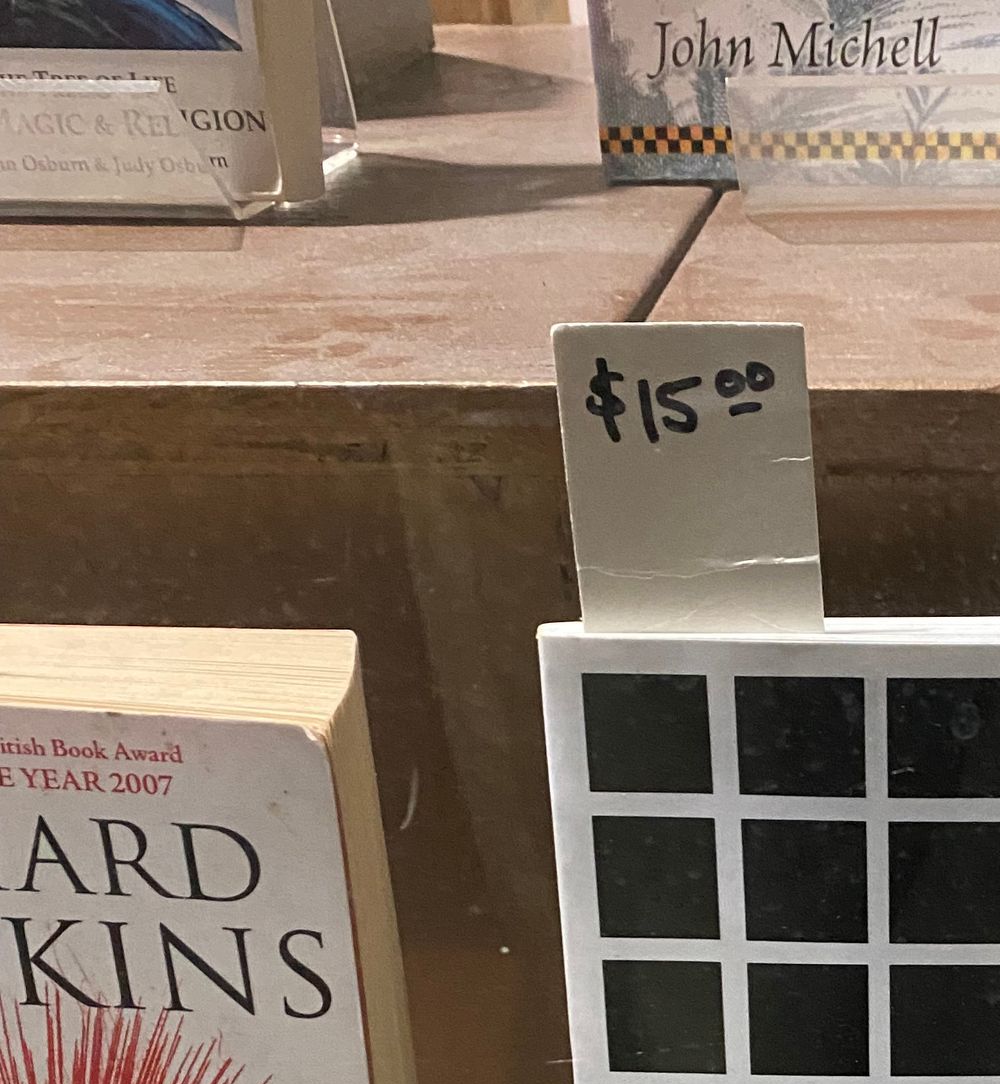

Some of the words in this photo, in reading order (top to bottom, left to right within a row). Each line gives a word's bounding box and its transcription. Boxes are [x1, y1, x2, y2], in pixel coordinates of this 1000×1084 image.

[646, 16, 755, 80] John
[767, 15, 942, 69] Michell
[0, 108, 85, 136] AGIC
[51, 738, 109, 760] Book
[114, 740, 184, 765] Award
[18, 767, 106, 794] YEAR
[109, 772, 174, 796] 2007
[0, 814, 262, 903] ARD
[1, 915, 334, 1020] KINS
